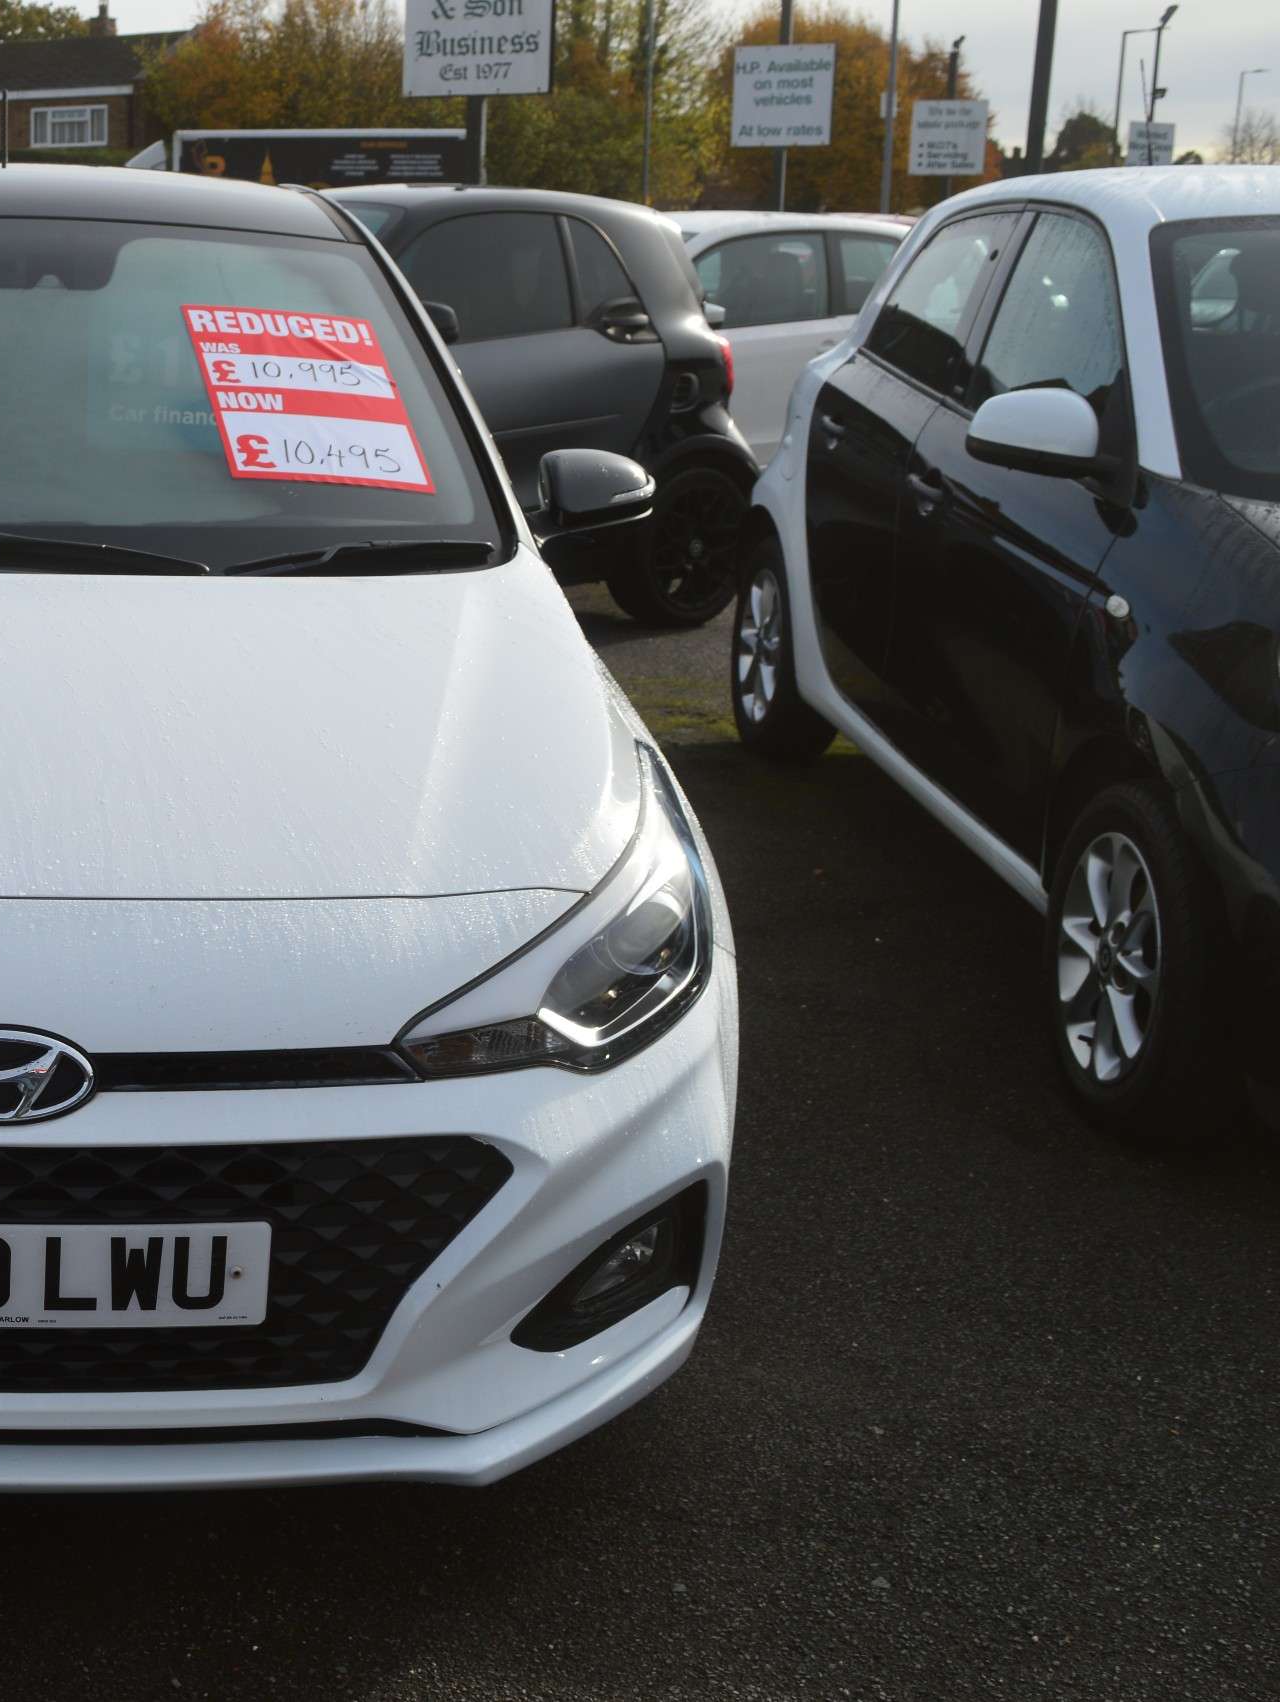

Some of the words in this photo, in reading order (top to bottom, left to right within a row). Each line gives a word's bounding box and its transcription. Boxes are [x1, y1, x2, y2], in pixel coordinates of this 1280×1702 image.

[463, 0, 523, 18] Son
[415, 29, 541, 59] Business
[439, 63, 468, 81] Est
[476, 62, 512, 80] 1977
[767, 58, 832, 73] Available
[753, 79, 772, 90] on
[777, 76, 814, 89] most
[753, 93, 813, 107] vehicles
[738, 125, 754, 137] At
[757, 124, 783, 137] low
[785, 125, 823, 136] rates
[187, 309, 374, 346] REDUCED!
[200, 341, 241, 354] WAS
[216, 391, 284, 411] NOW
[153, 404, 218, 426] financ
[43, 1235, 228, 1312] LWU
